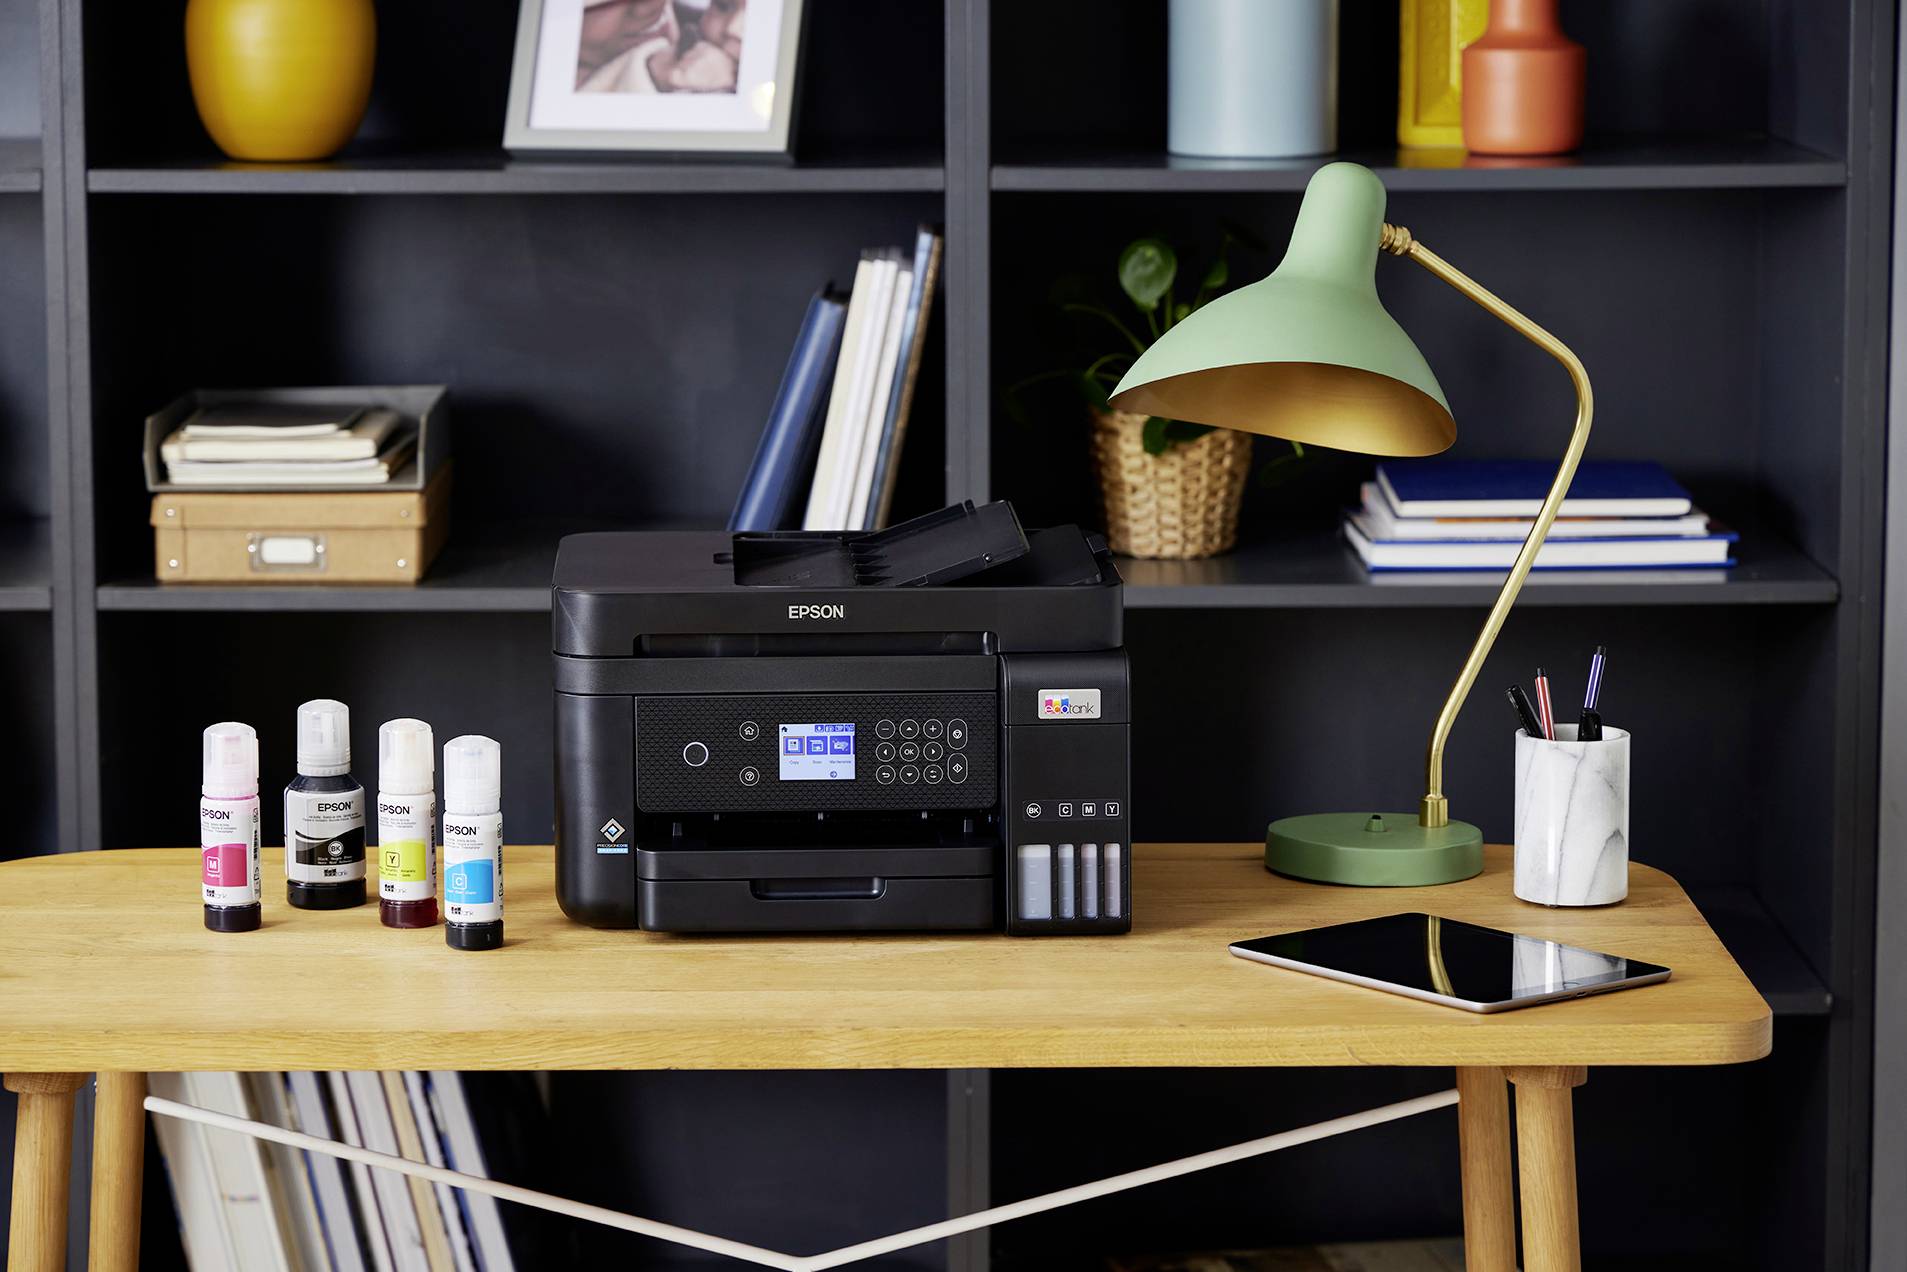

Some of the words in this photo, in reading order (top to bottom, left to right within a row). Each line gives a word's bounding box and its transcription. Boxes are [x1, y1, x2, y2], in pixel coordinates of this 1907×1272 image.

[788, 604, 844, 619] EPSON
[903, 748, 914, 756] OK
[317, 801, 352, 812] EPSON
[380, 803, 410, 815] EPSON
[1062, 806, 1069, 814] C
[1085, 806, 1093, 814] M
[1109, 805, 1115, 814] Y
[389, 855, 396, 864] Y
[209, 860, 217, 870] M
[455, 877, 463, 886] C
